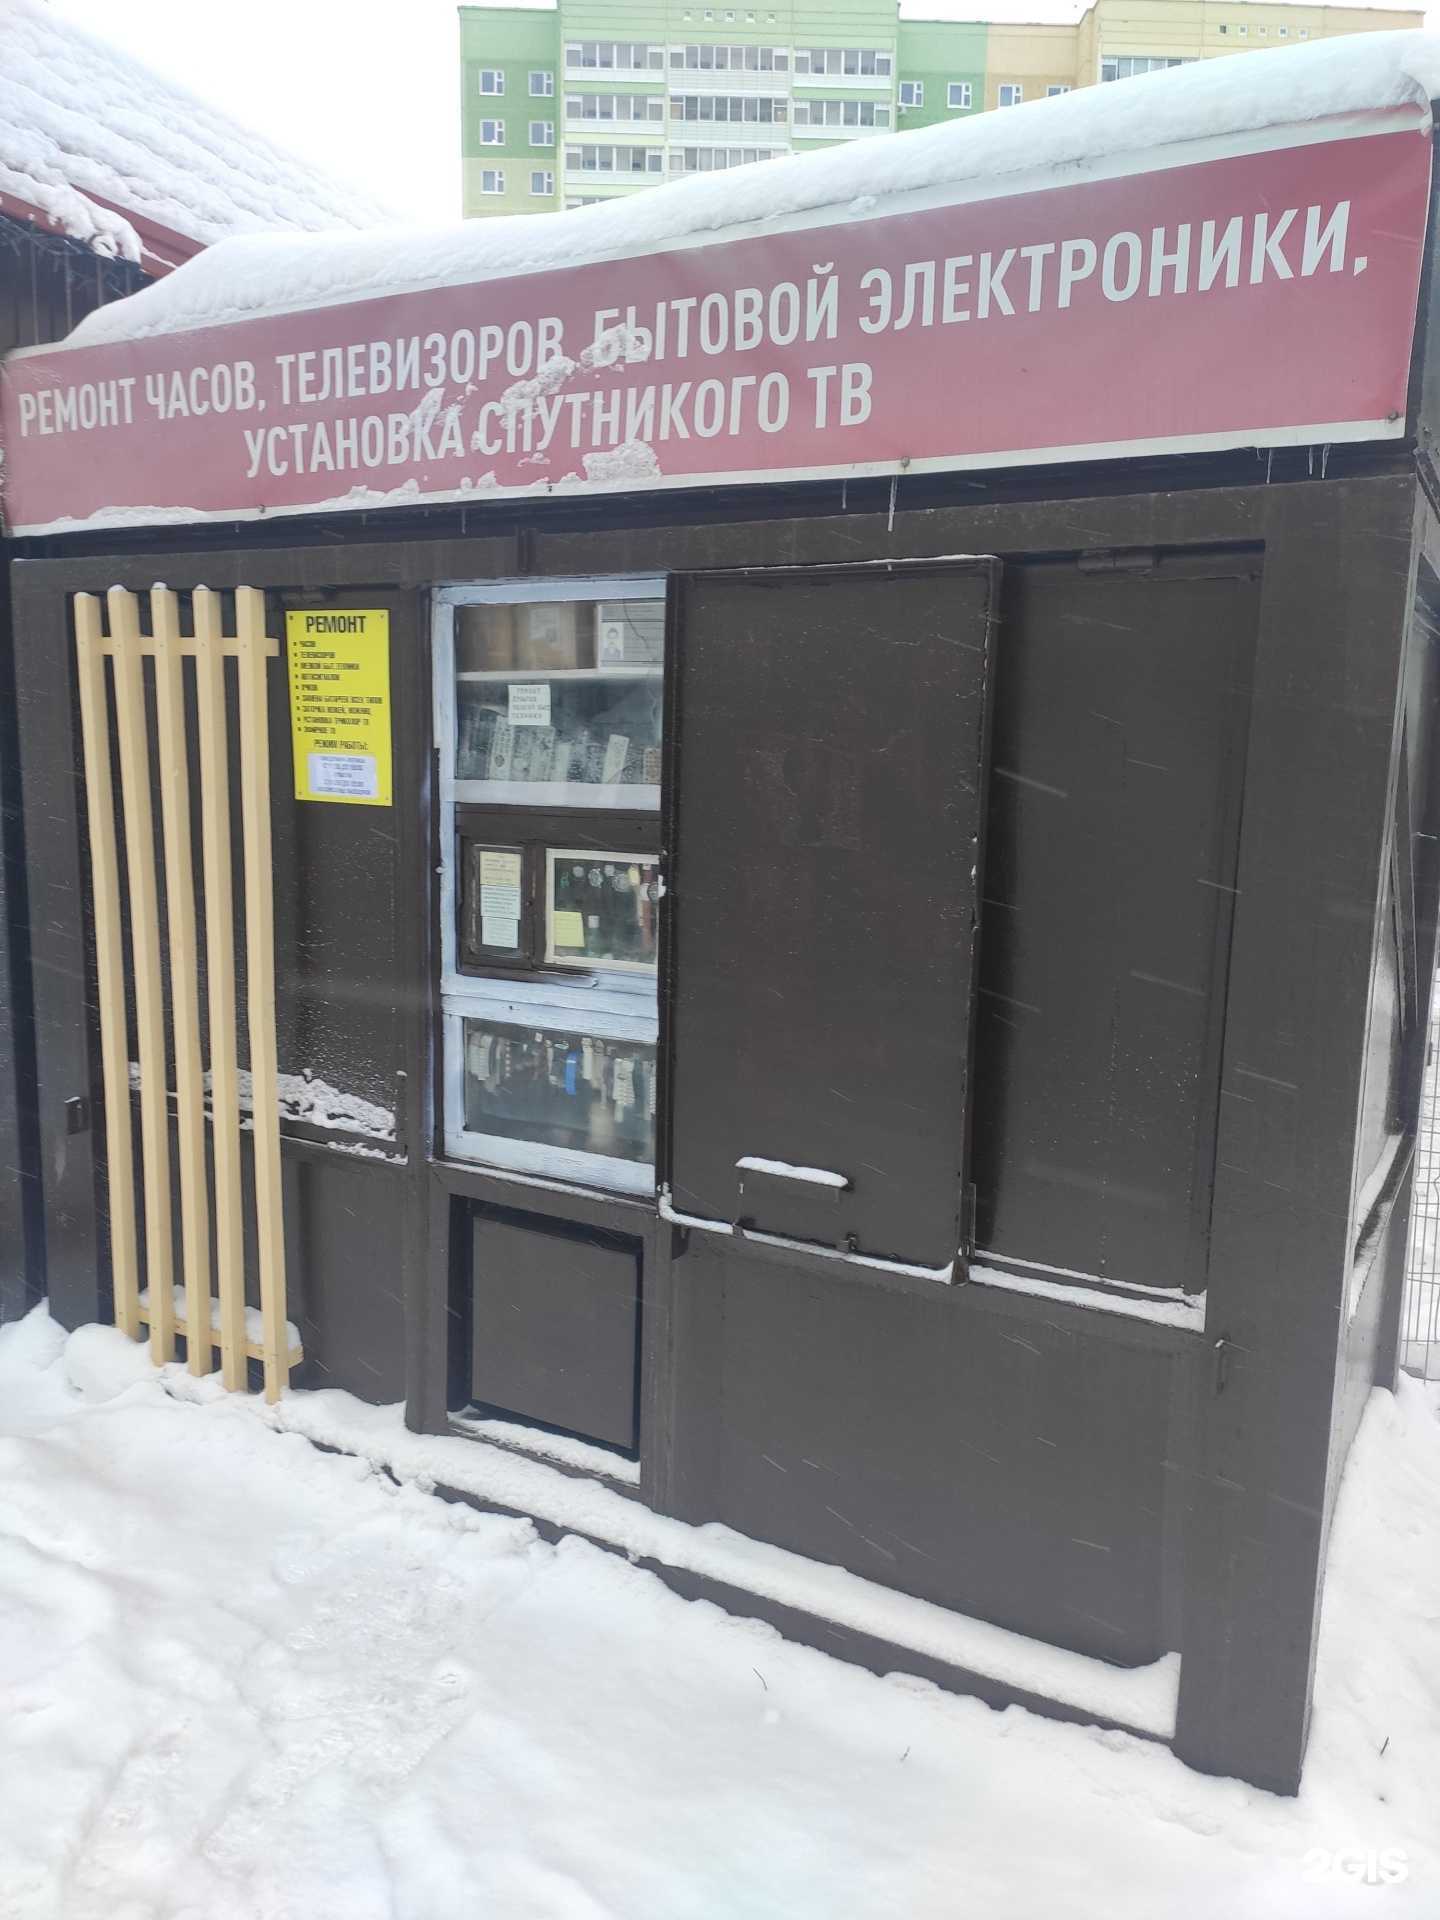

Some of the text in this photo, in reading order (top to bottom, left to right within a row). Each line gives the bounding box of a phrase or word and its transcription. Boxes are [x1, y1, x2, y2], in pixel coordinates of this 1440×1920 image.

[18, 377, 136, 437] РЕМОНТ
[145, 360, 266, 421] ЧАСОВ,
[857, 200, 1368, 335] ЭЛЕКТРОНИКИ,
[243, 362, 874, 478] УСТАНОВКА СПУТНИКОГО ТВ
[305, 615, 367, 634] РЕМОНТ
